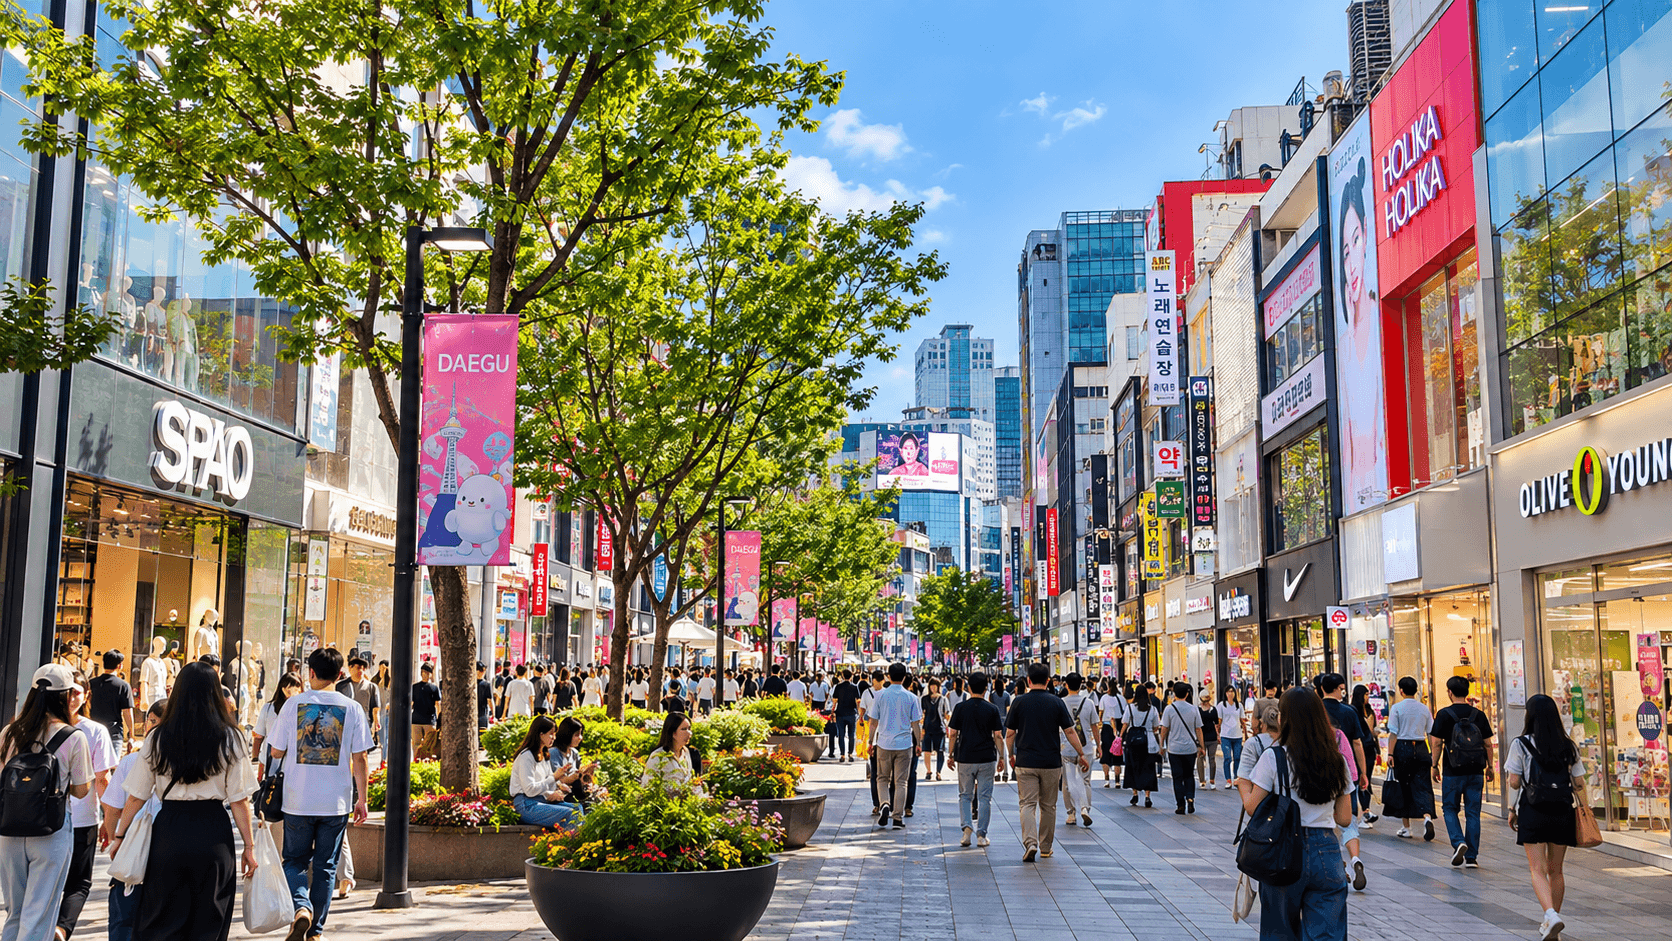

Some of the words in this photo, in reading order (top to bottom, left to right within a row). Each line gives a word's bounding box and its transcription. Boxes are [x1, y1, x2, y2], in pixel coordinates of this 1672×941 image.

[1382, 105, 1441, 192] HOLIKA
[1385, 155, 1446, 238] HOLIKA
[438, 353, 509, 373] DAEGU
[148, 400, 254, 500] SPAO
[1158, 446, 1181, 470] 약
[1519, 470, 1570, 518] OLIVE
[1606, 437, 1672, 495] YOUN
